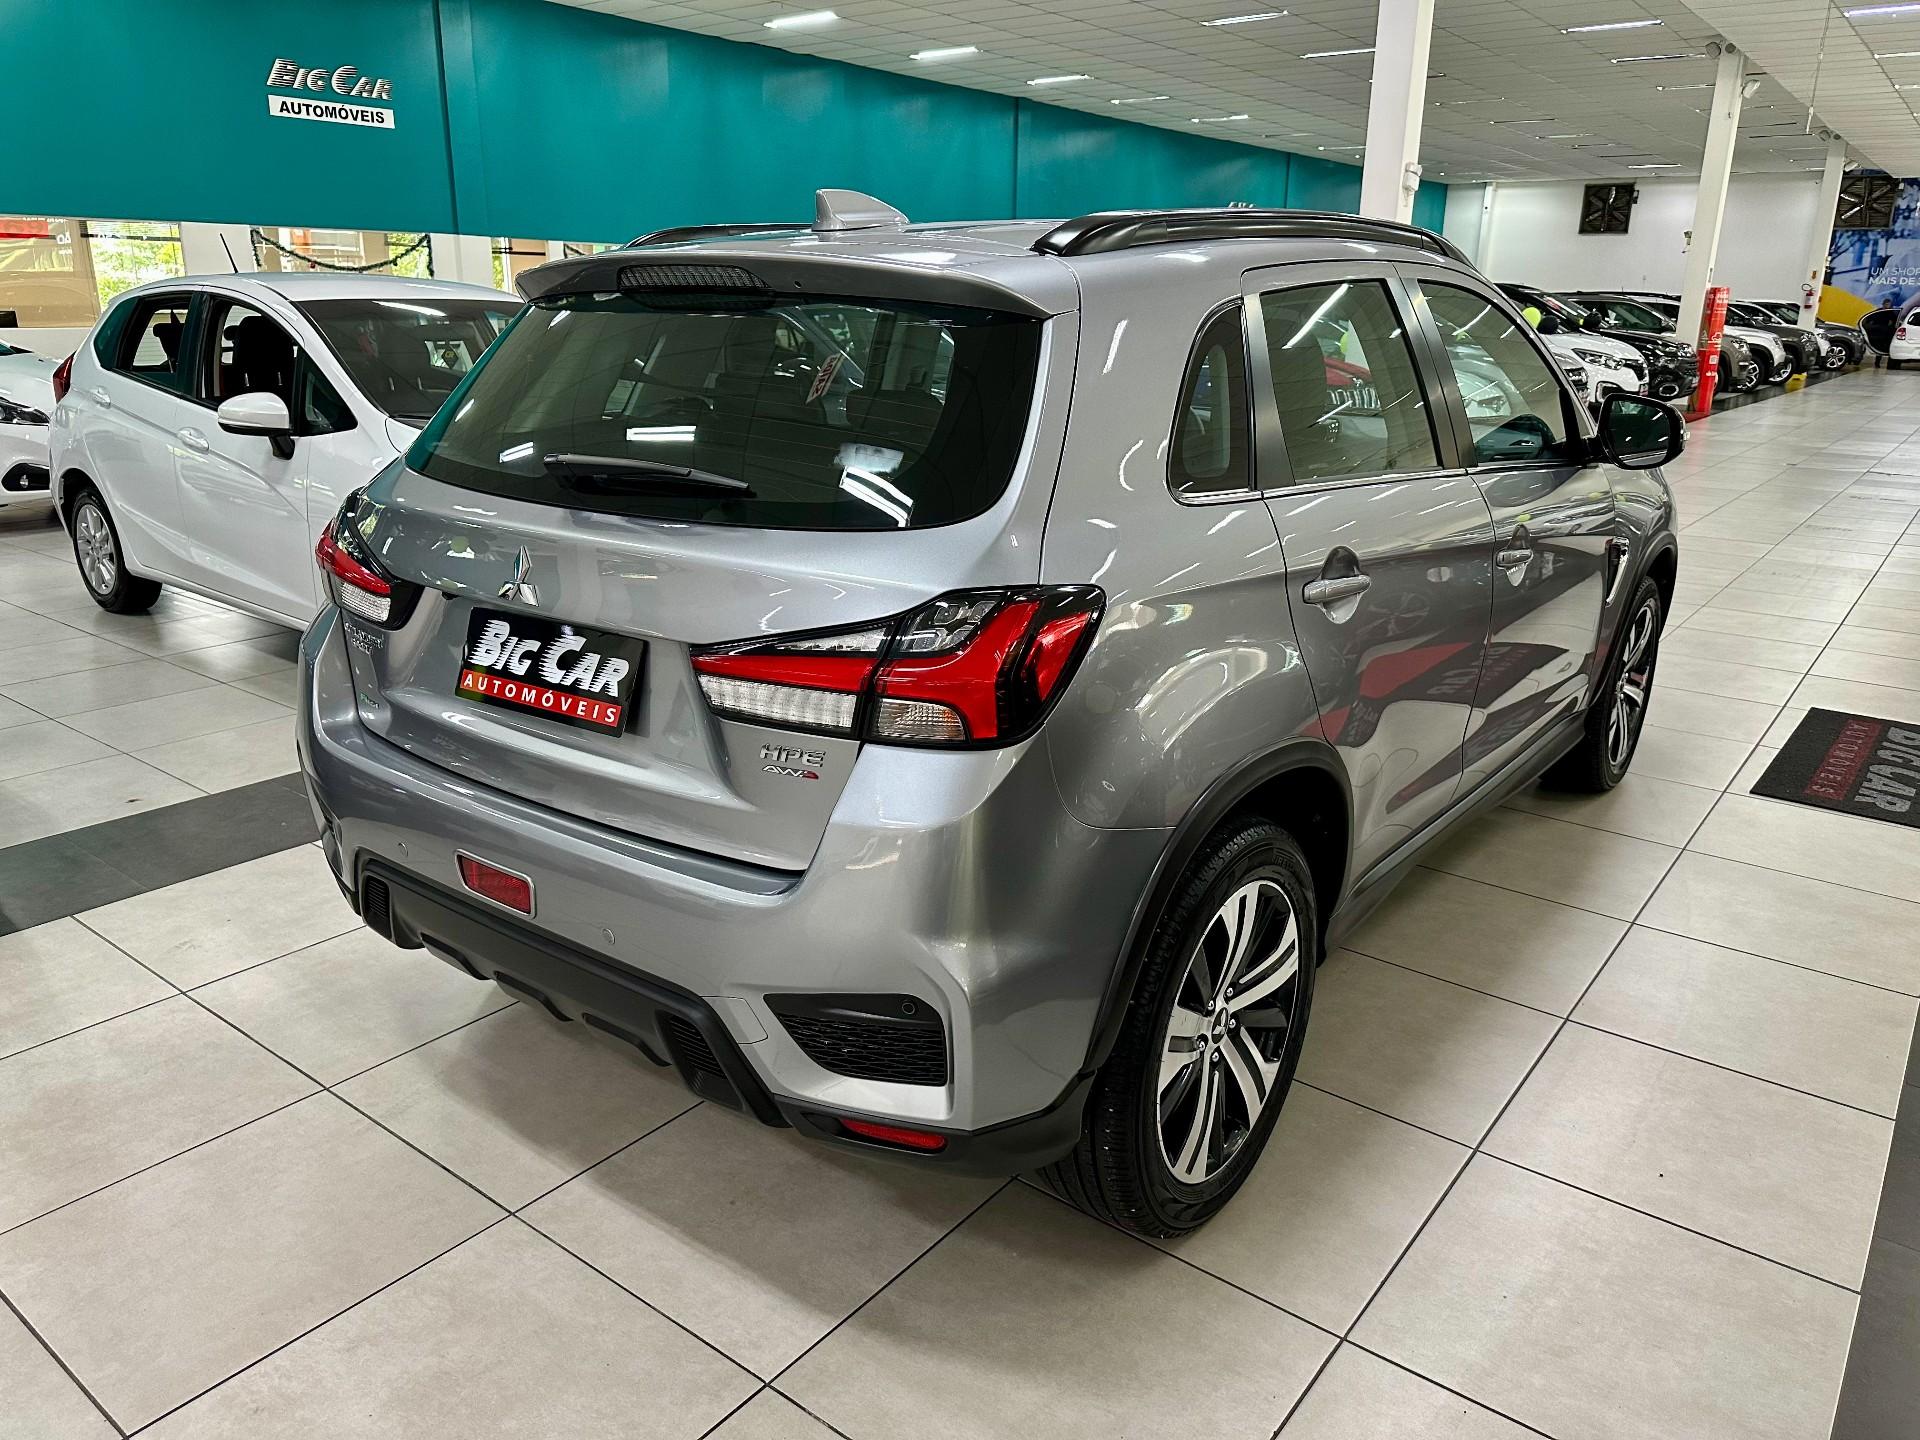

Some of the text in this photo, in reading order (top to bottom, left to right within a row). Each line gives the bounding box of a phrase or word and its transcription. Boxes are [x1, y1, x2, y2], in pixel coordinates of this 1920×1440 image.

[331, 65, 393, 101] CAR
[279, 100, 385, 124] AUTOMÓVEIS
[1869, 277, 1897, 285] MAIS
[1900, 277, 1915, 285] DE
[1871, 267, 1889, 276] UM
[467, 619, 630, 698] BIG CAR
[463, 673, 618, 723] AUTOMÓVEIS
[760, 743, 826, 767] HPE
[1811, 722, 1870, 793] AUTOMÓVEIS
[1854, 763, 1920, 813] CAR
